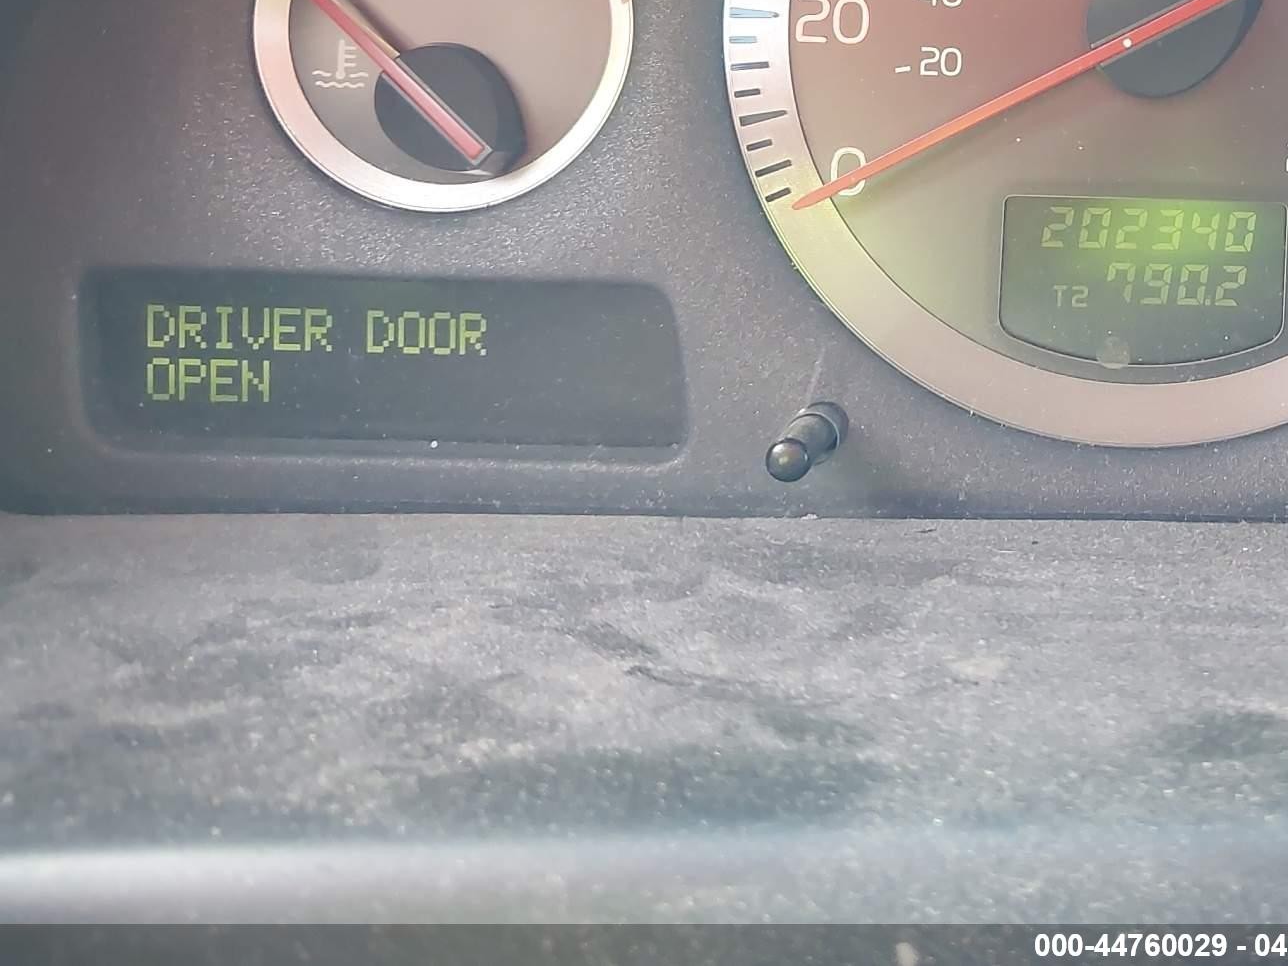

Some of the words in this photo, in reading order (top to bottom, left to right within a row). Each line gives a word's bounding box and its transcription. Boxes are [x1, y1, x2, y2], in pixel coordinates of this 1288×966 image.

[919, 49, 962, 77] 20
[831, 147, 867, 196] 0
[1040, 206, 1256, 253] 202340
[1052, 285, 1088, 307] T2
[1106, 262, 1247, 308] 790.2
[146, 304, 332, 352] DRIVER
[366, 309, 487, 355] DOOR
[146, 358, 270, 402] OPEN
